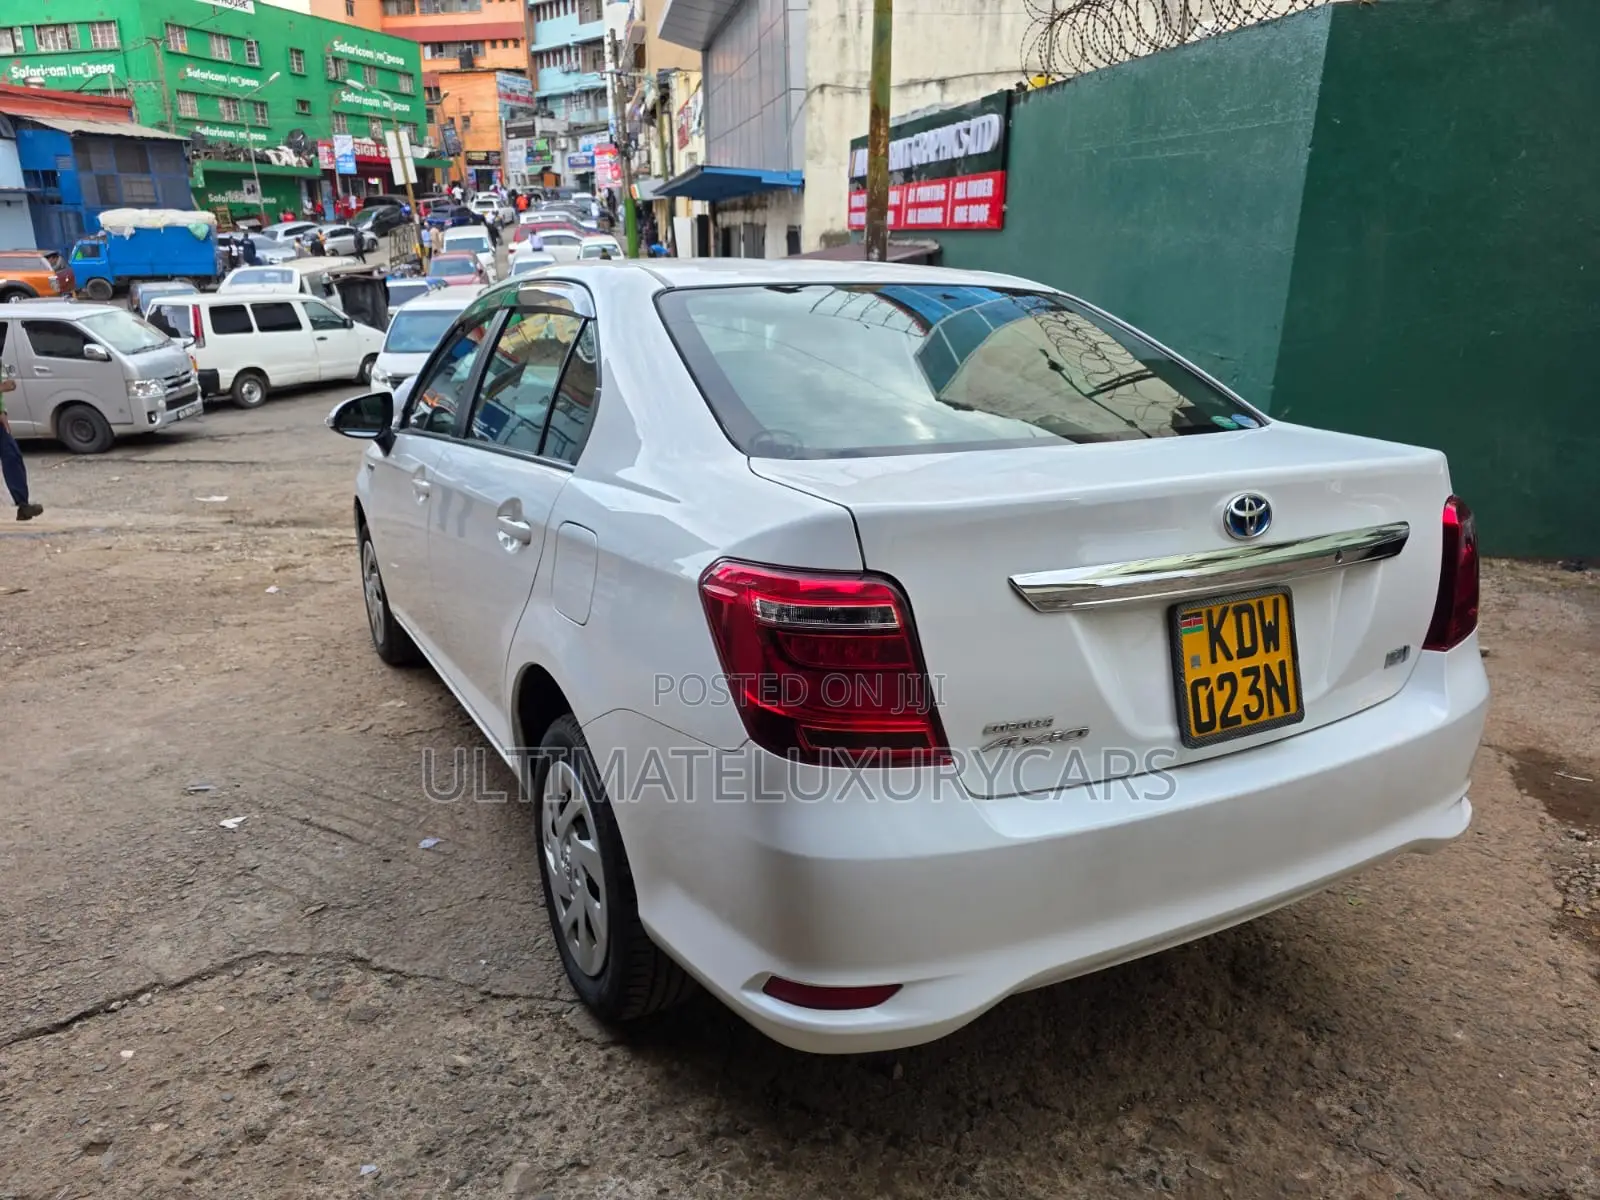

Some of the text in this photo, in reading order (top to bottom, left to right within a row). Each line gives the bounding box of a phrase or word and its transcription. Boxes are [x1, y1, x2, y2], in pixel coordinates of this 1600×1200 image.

[333, 40, 374, 59] Safaricom
[11, 64, 67, 79] Safaricom
[186, 67, 227, 82] Safaricom
[1206, 598, 1281, 665] KDW
[1189, 659, 1291, 734] 023N
